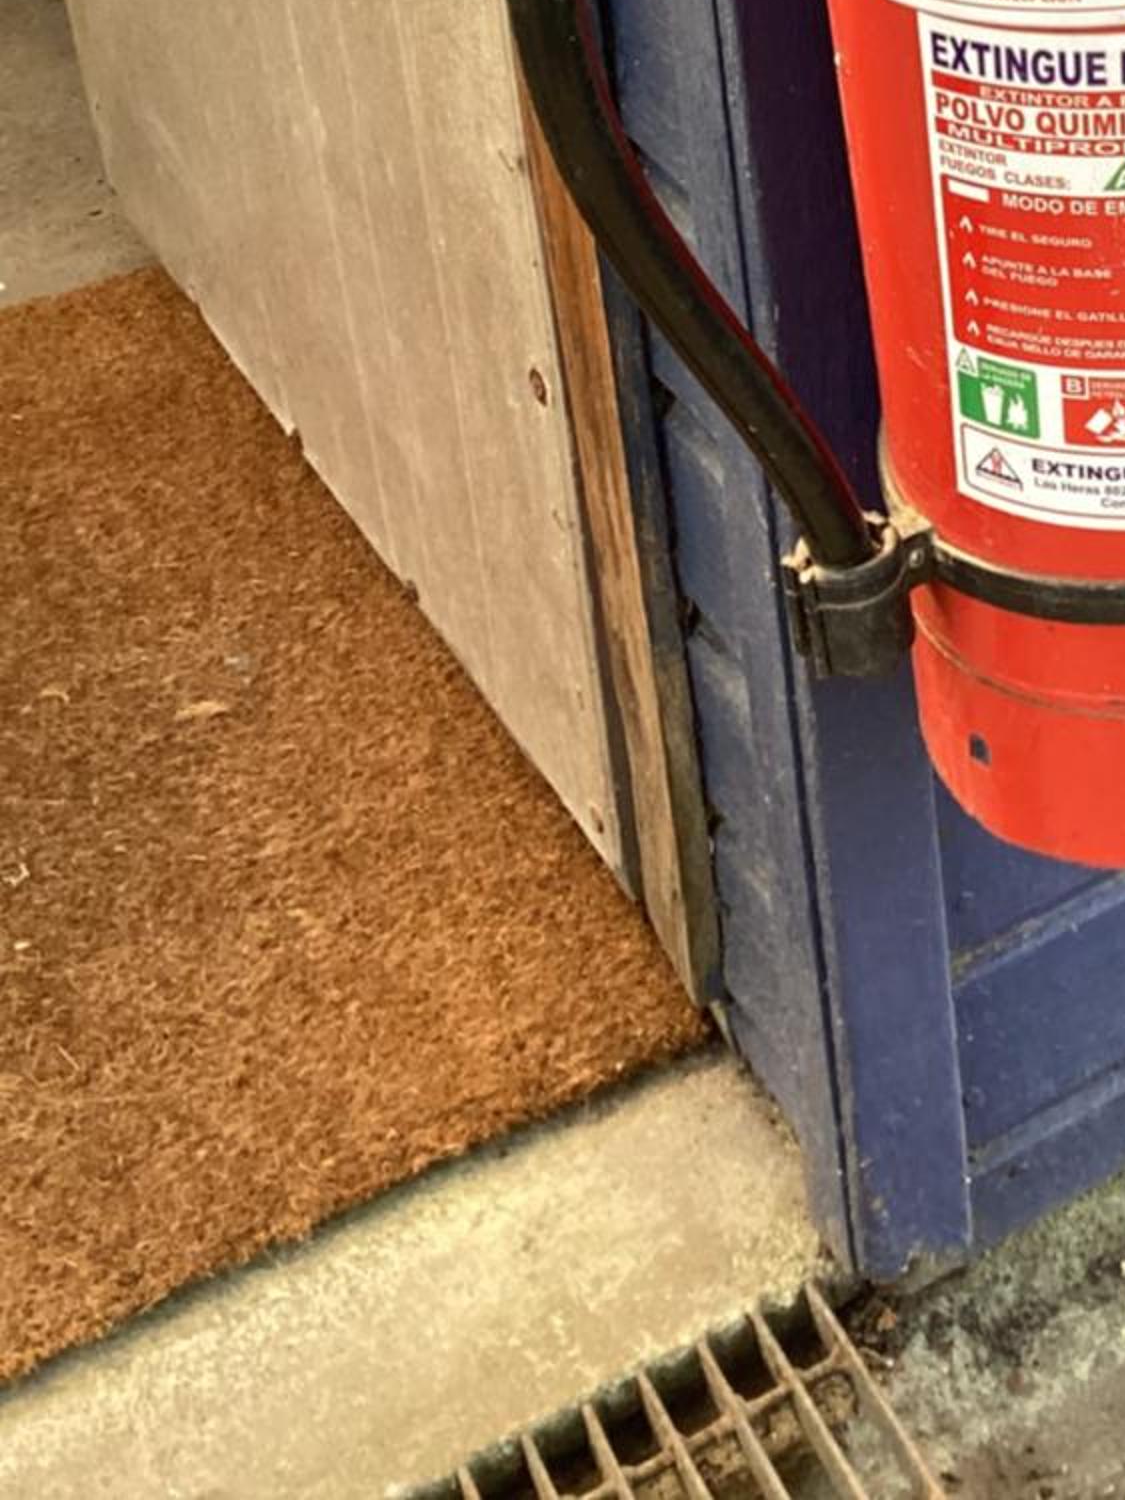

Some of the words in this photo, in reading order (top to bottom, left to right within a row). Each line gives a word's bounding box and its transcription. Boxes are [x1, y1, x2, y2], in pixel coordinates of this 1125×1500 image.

[930, 30, 1107, 87] EXTINGUE
[979, 85, 1089, 107] EXTINTOR
[1096, 95, 1114, 108] A
[935, 91, 1026, 132] POLVO
[938, 138, 1008, 166] EXTINTOR
[940, 154, 997, 181] FUEGOS
[1003, 171, 1072, 190] CLASES:
[1002, 192, 1065, 215] MODO
[1069, 199, 1098, 216] DE
[1010, 230, 1028, 242] EL
[1031, 233, 1093, 248] SEGURO
[980, 254, 1034, 273] APUNTE
[1072, 268, 1112, 279] BASE
[980, 265, 1007, 280] DEL
[1010, 271, 1059, 287] FUEGO
[982, 296, 1052, 319] PRESIONE
[1055, 308, 1073, 321] EL
[1065, 377, 1083, 393] B
[1061, 480, 1101, 495] Heras
